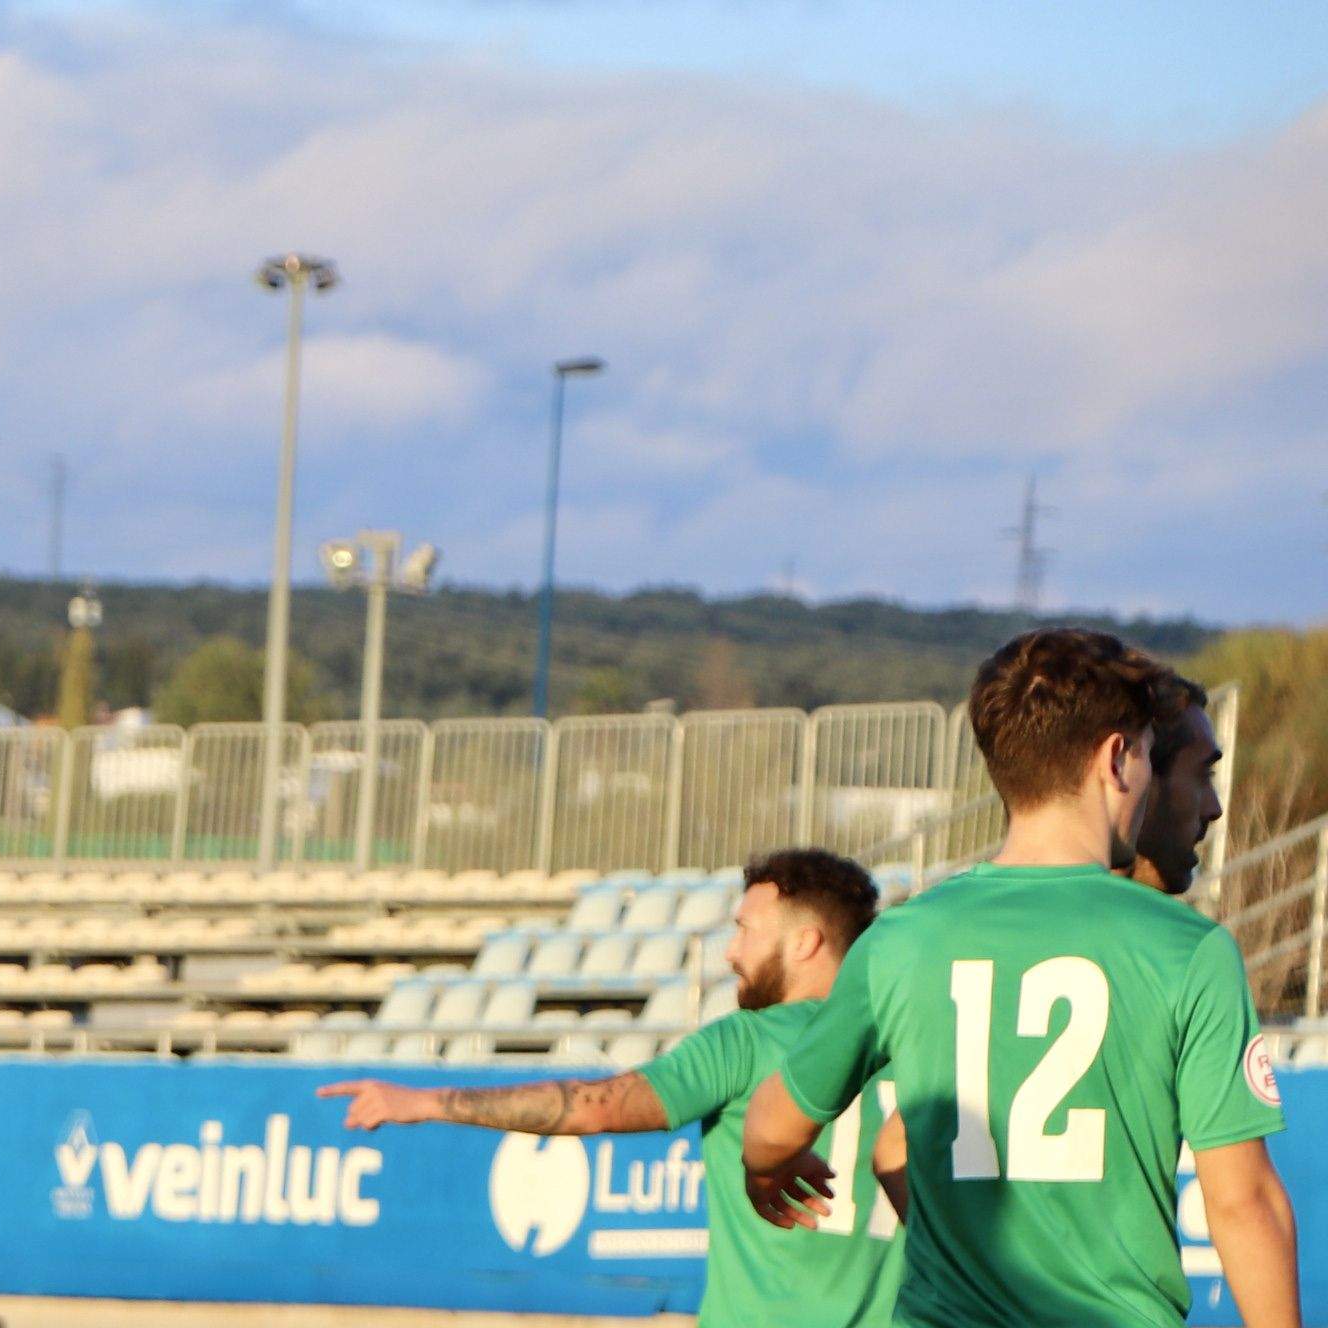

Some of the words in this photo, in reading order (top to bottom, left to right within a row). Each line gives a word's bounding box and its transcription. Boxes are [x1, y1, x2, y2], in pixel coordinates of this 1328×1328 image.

[949, 956, 1110, 1182] 12
[99, 1112, 384, 1227] veinluc
[595, 1138, 706, 1214] Lufr
